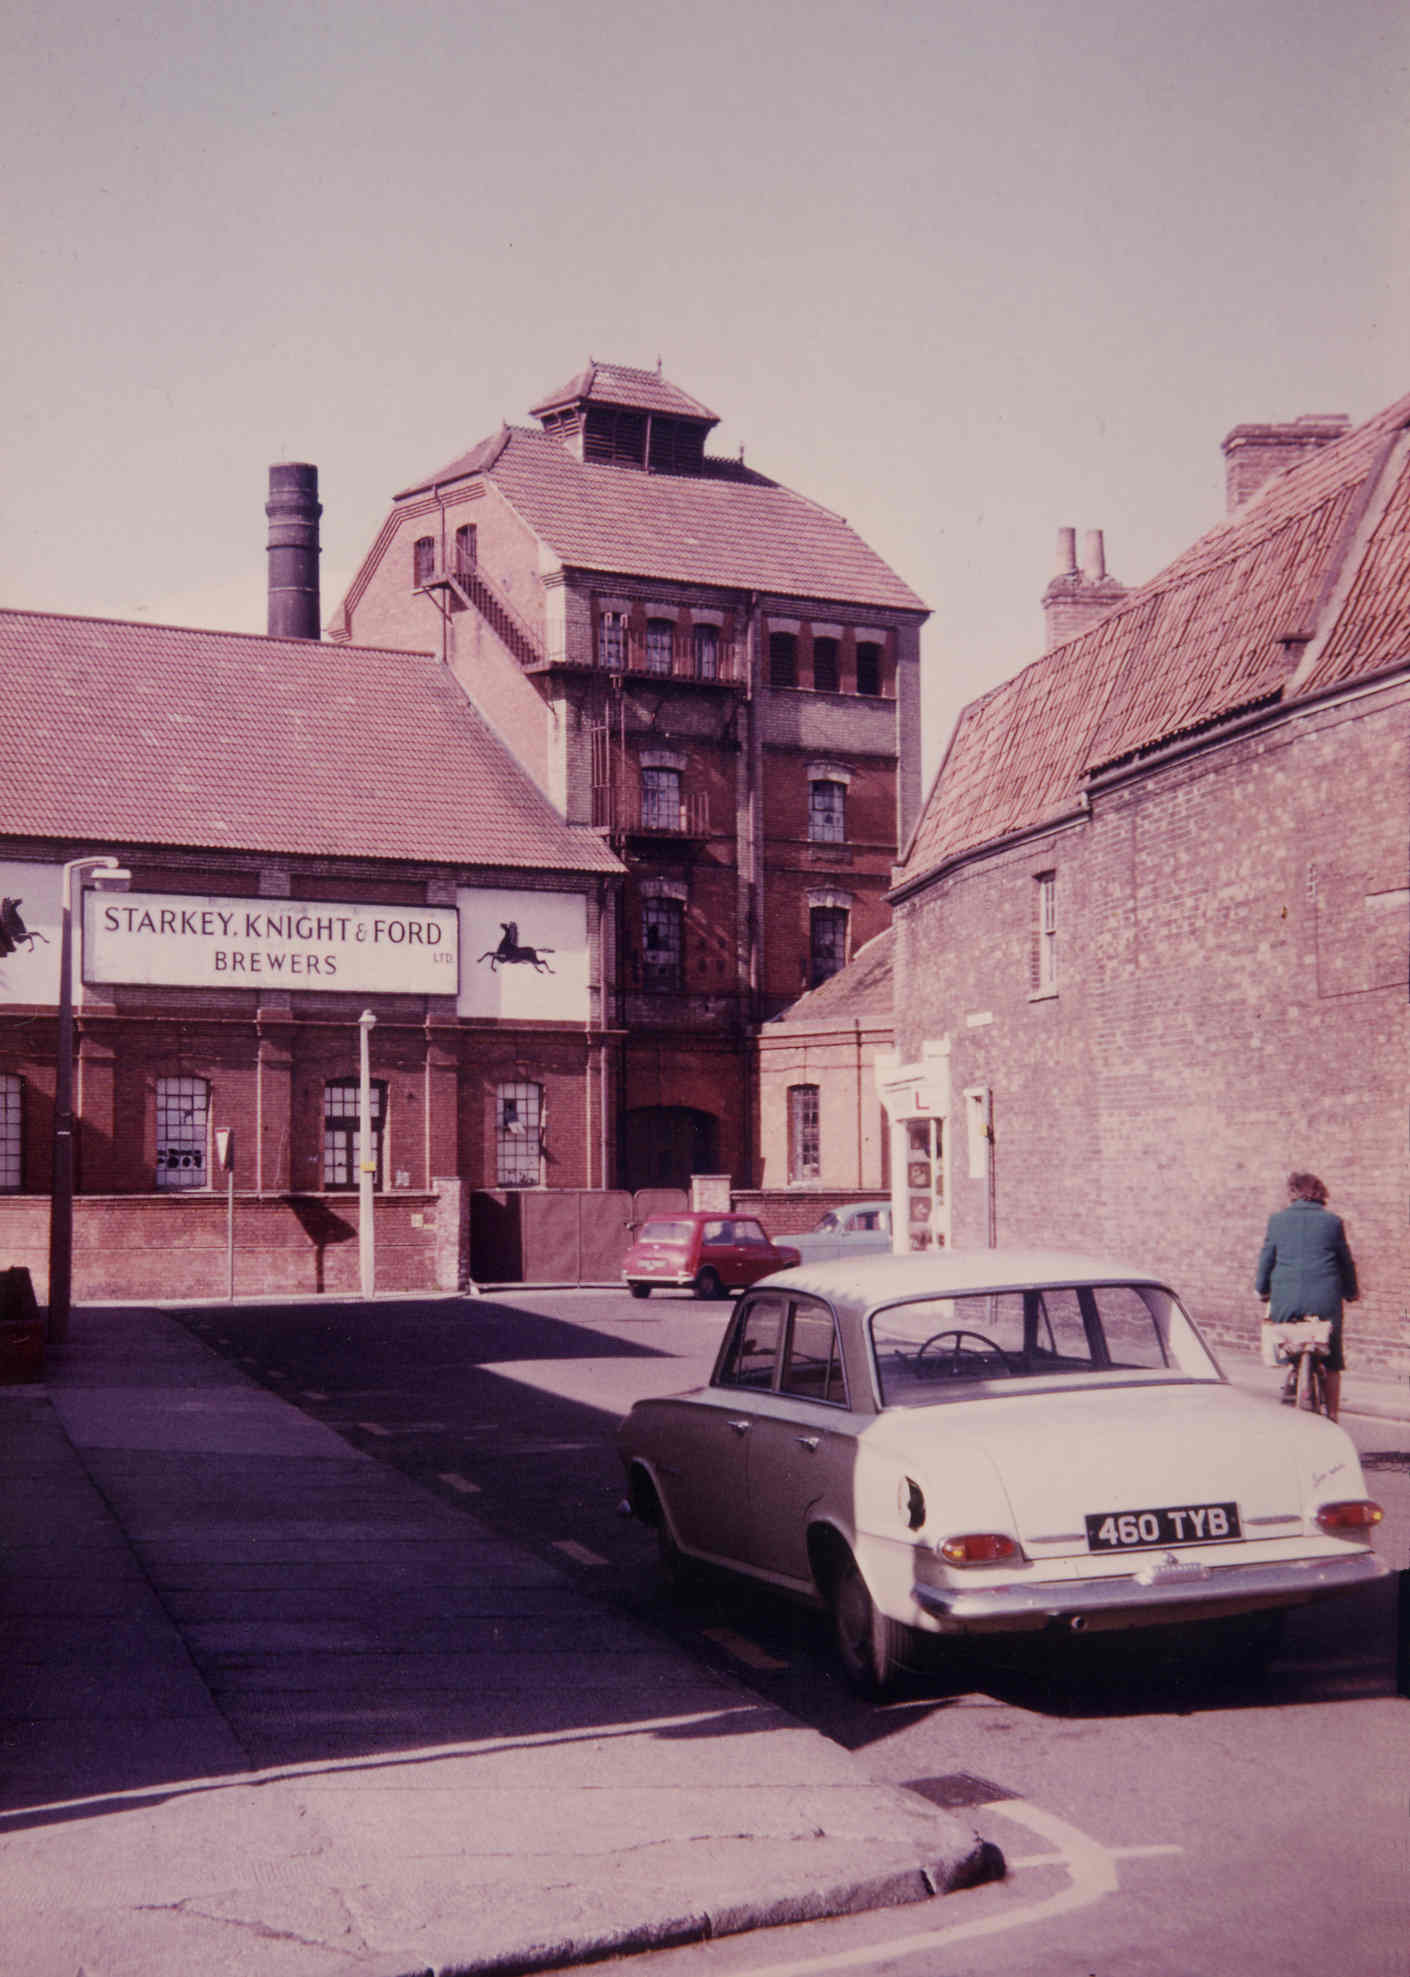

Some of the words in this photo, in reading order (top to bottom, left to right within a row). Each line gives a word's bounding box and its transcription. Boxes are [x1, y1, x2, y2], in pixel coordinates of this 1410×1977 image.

[245, 912, 351, 942] KNIGHT
[355, 922, 368, 943] &
[374, 919, 442, 946] FORD
[215, 951, 337, 976] BREWERS
[1098, 1513, 1160, 1545] 460
[1167, 1507, 1229, 1540] TYB
